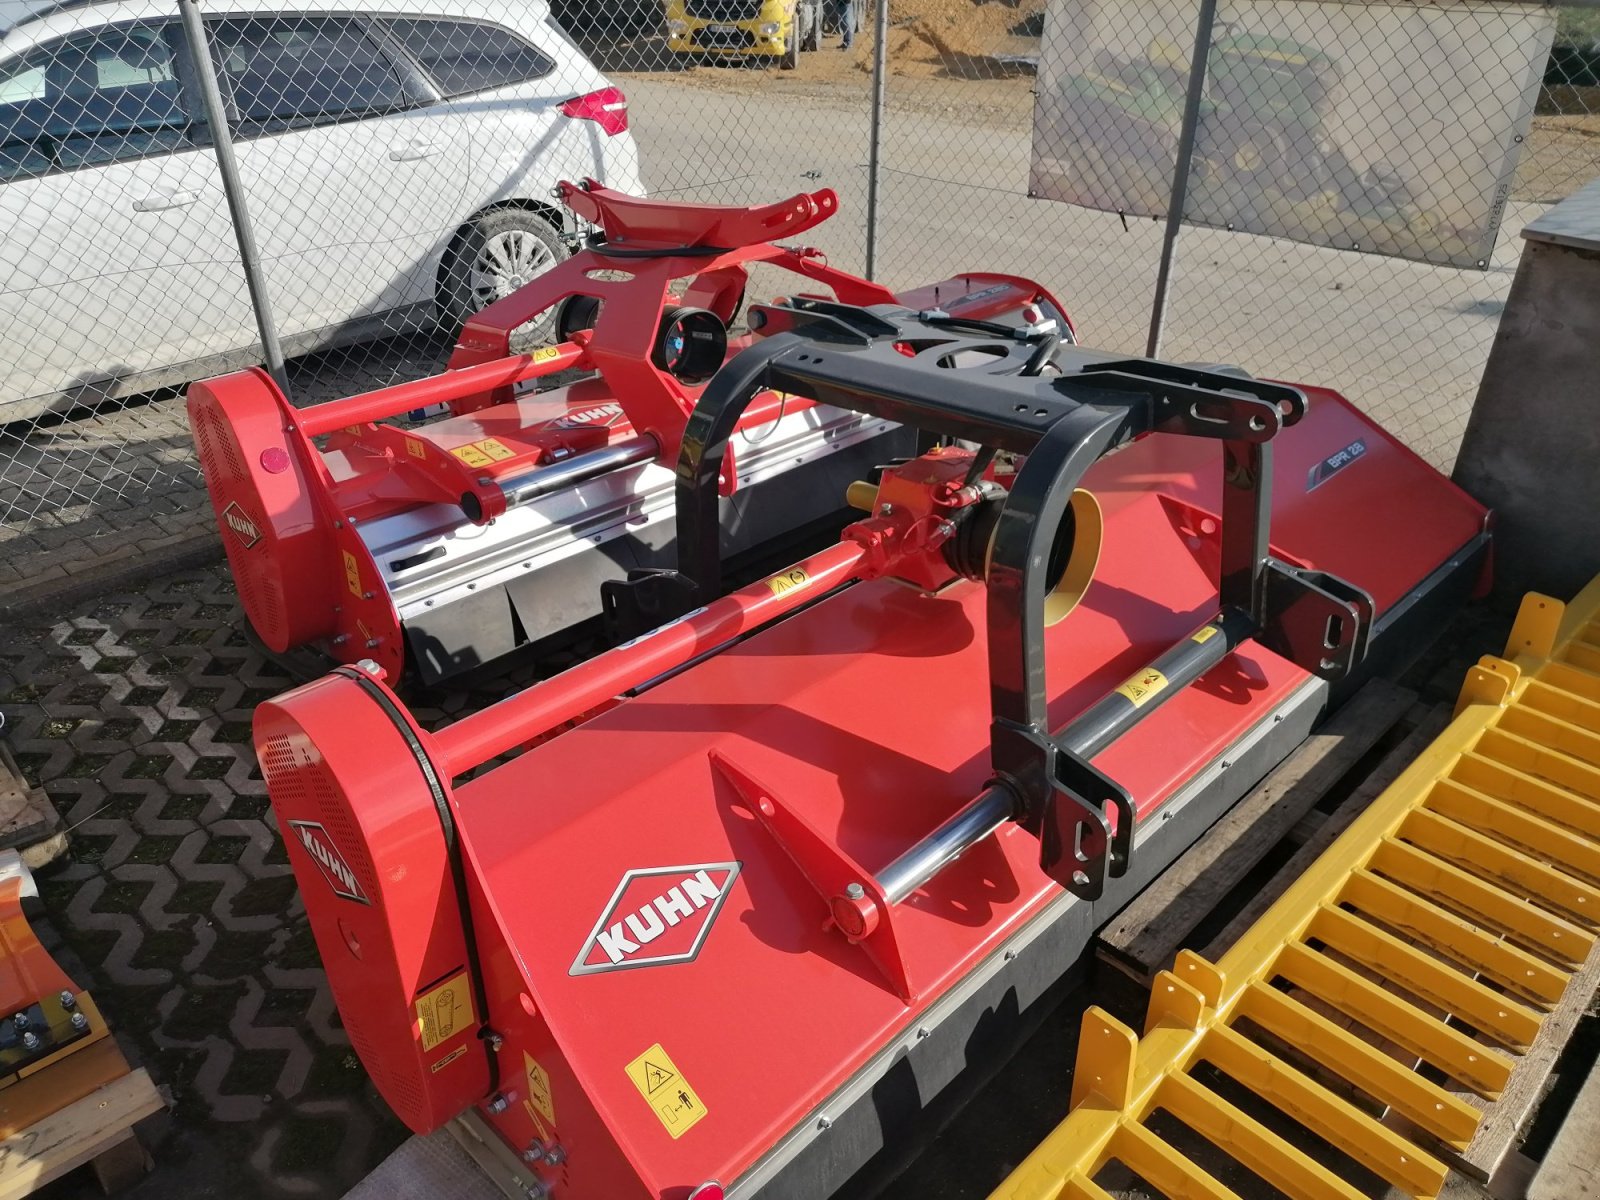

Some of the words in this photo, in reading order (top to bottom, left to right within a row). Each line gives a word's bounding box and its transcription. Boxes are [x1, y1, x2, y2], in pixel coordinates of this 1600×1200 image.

[555, 403, 623, 428] KUHN
[1327, 451, 1351, 468] BPR
[1347, 442, 1365, 456] 28
[226, 512, 257, 539] KUHN
[300, 825, 358, 897] KUHN
[595, 869, 722, 965] KUHN
